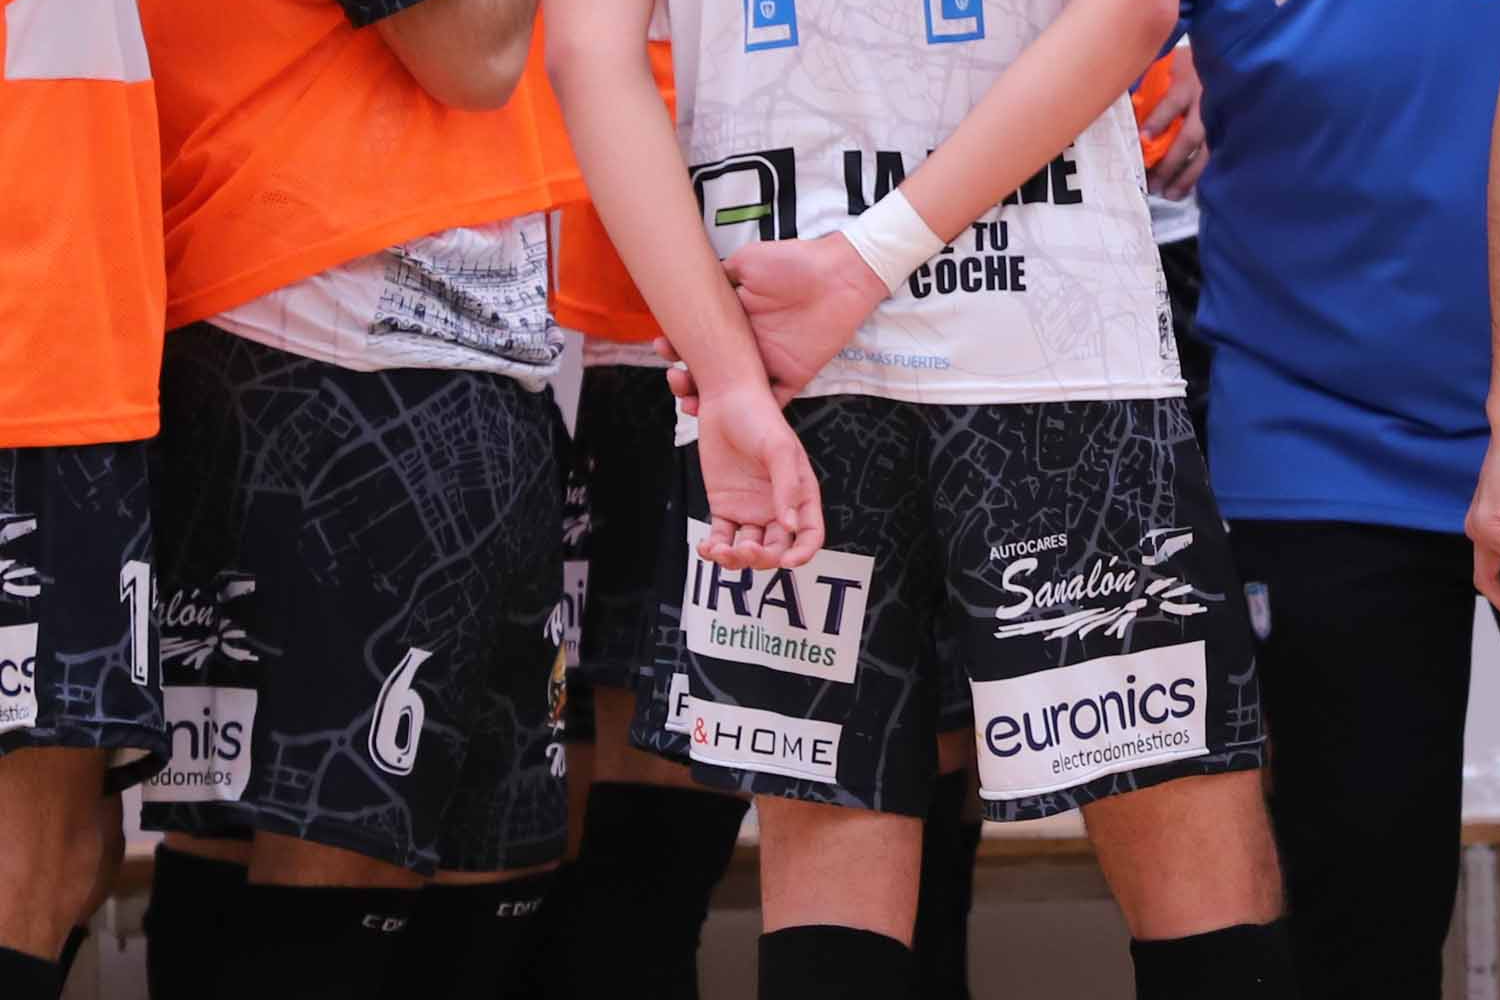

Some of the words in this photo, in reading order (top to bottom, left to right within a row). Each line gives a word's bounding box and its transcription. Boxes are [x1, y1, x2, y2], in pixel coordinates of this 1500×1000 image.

[973, 221, 1008, 251] TU
[909, 256, 1027, 299] COCHE
[989, 533, 1068, 562] AUTOCARES
[710, 618, 837, 667] fertilizantes
[368, 648, 432, 776] 6
[985, 674, 1196, 758] euronics
[1052, 728, 1192, 775] electrodomésticos
